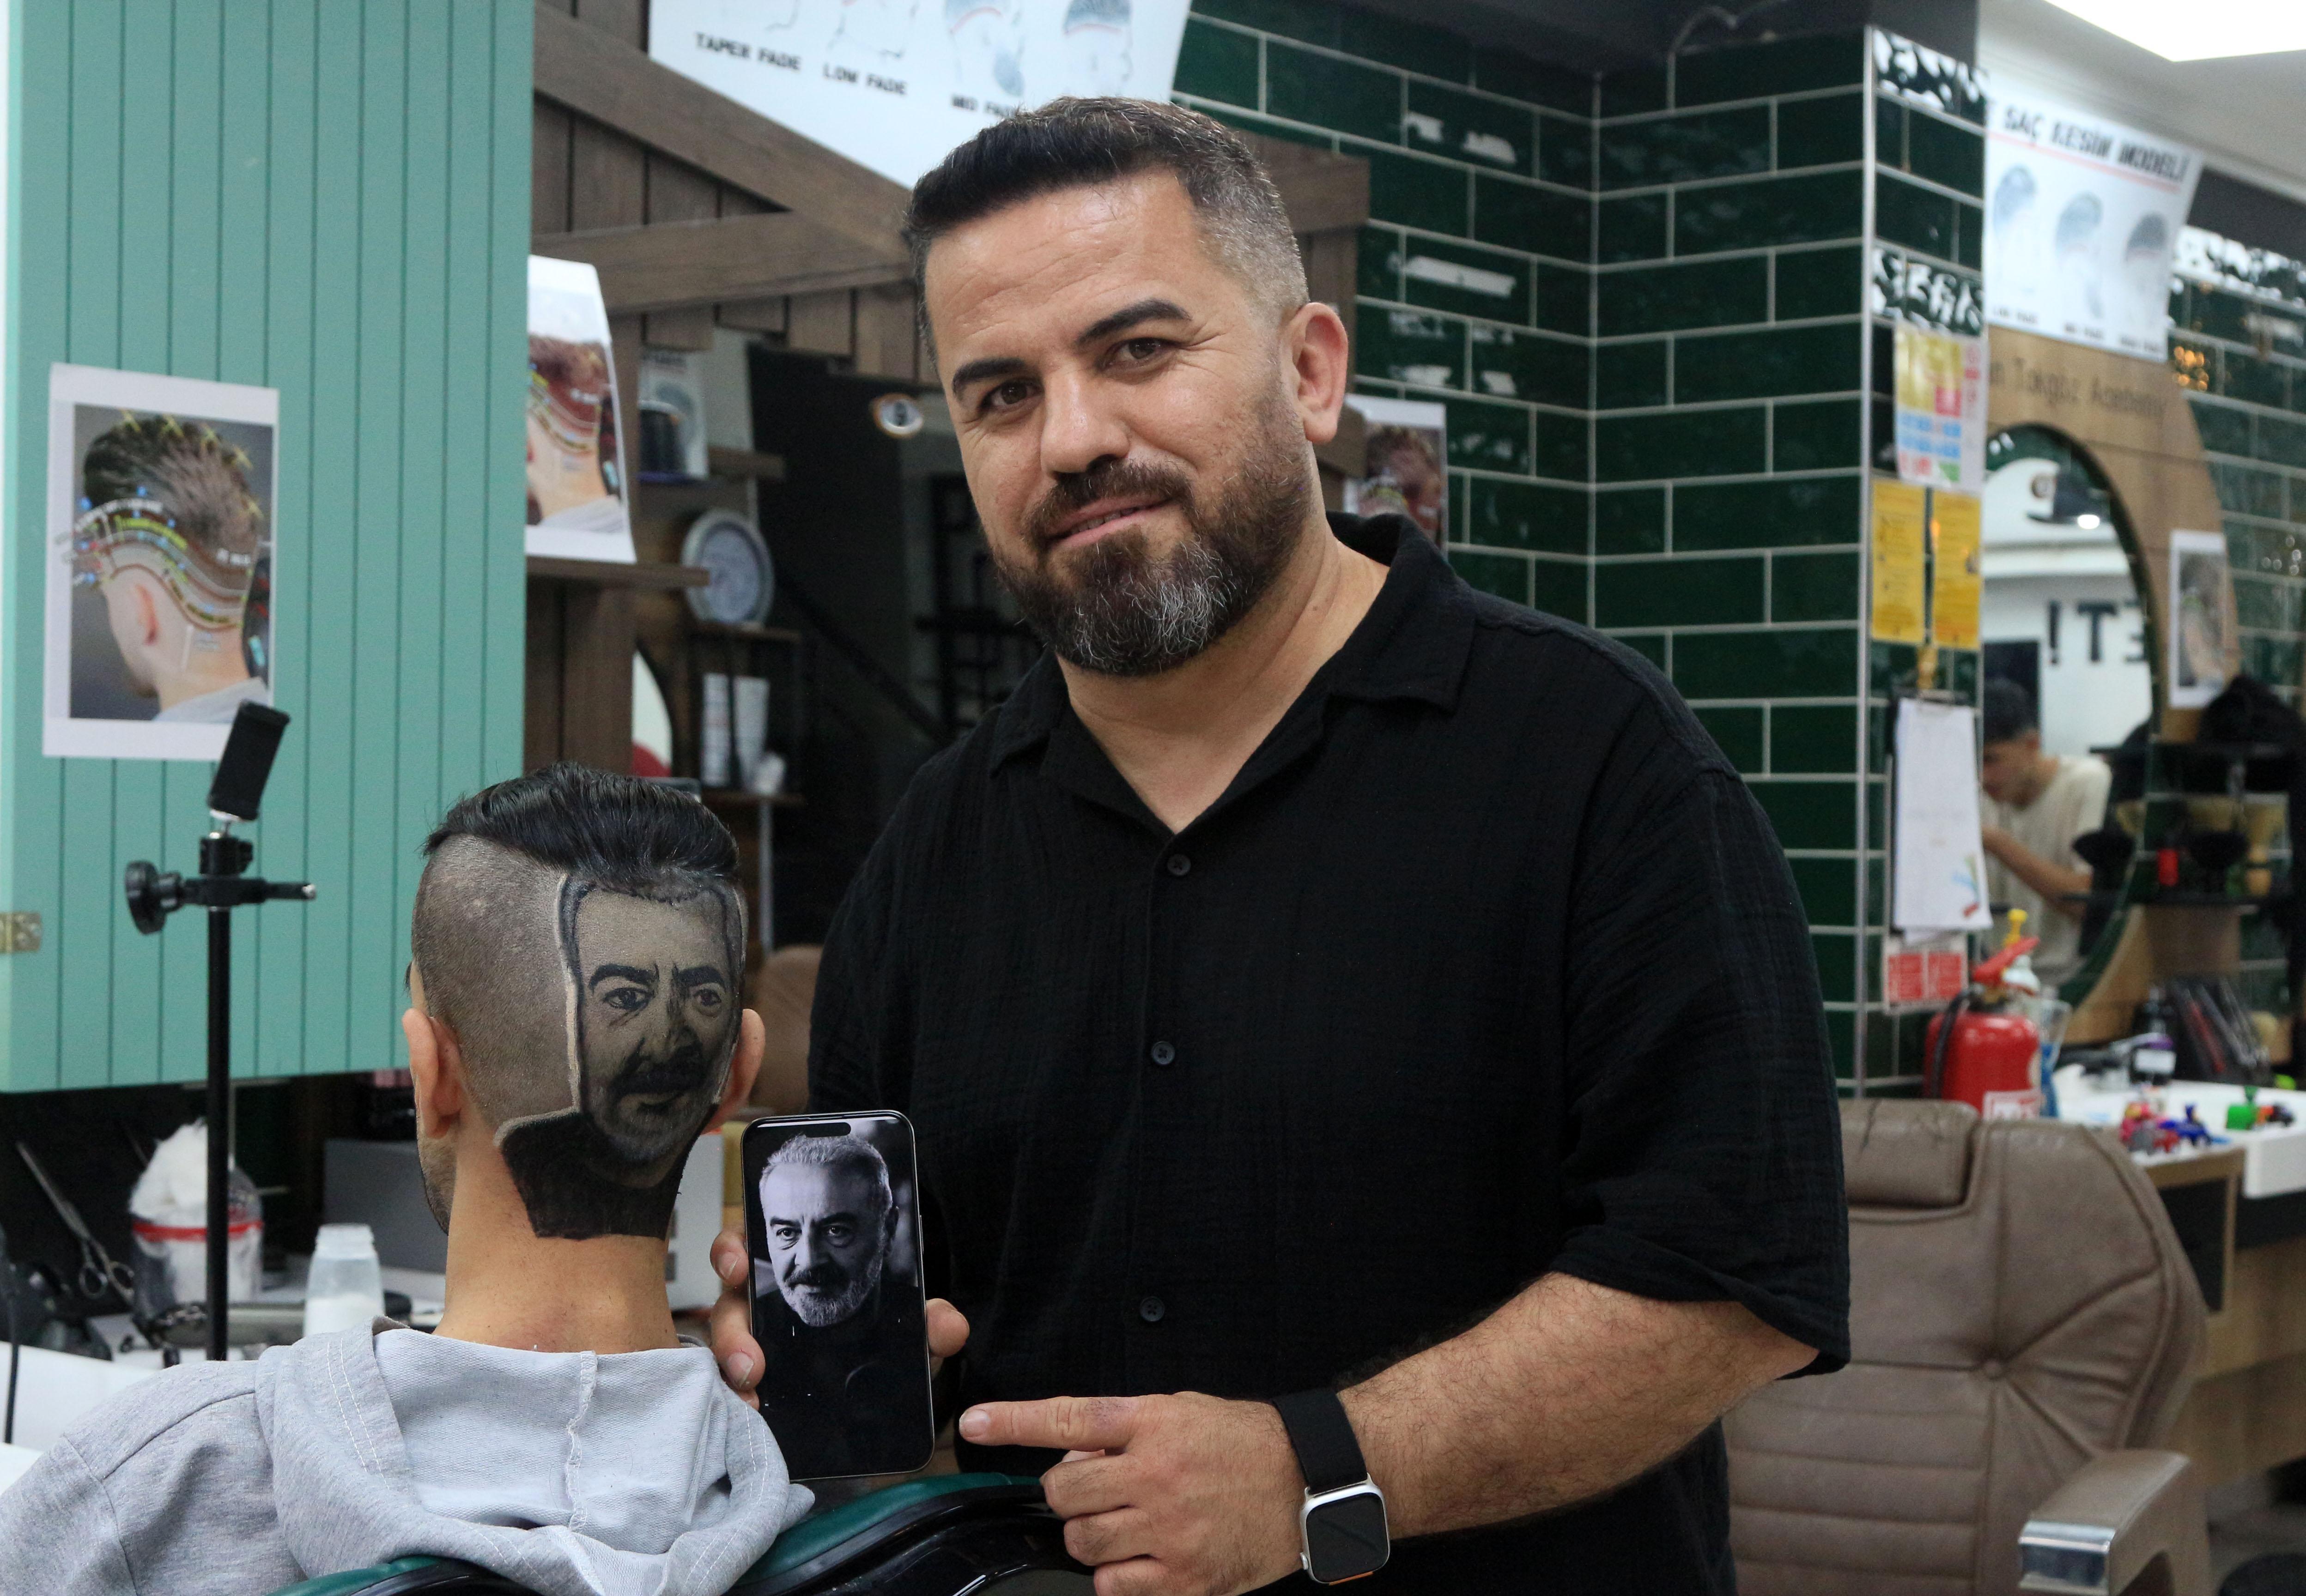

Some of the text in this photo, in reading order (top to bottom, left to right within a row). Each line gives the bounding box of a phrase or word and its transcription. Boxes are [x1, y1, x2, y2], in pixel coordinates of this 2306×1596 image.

[696, 32, 801, 71] TAPER FADE
[823, 63, 907, 95] LOW FADE
